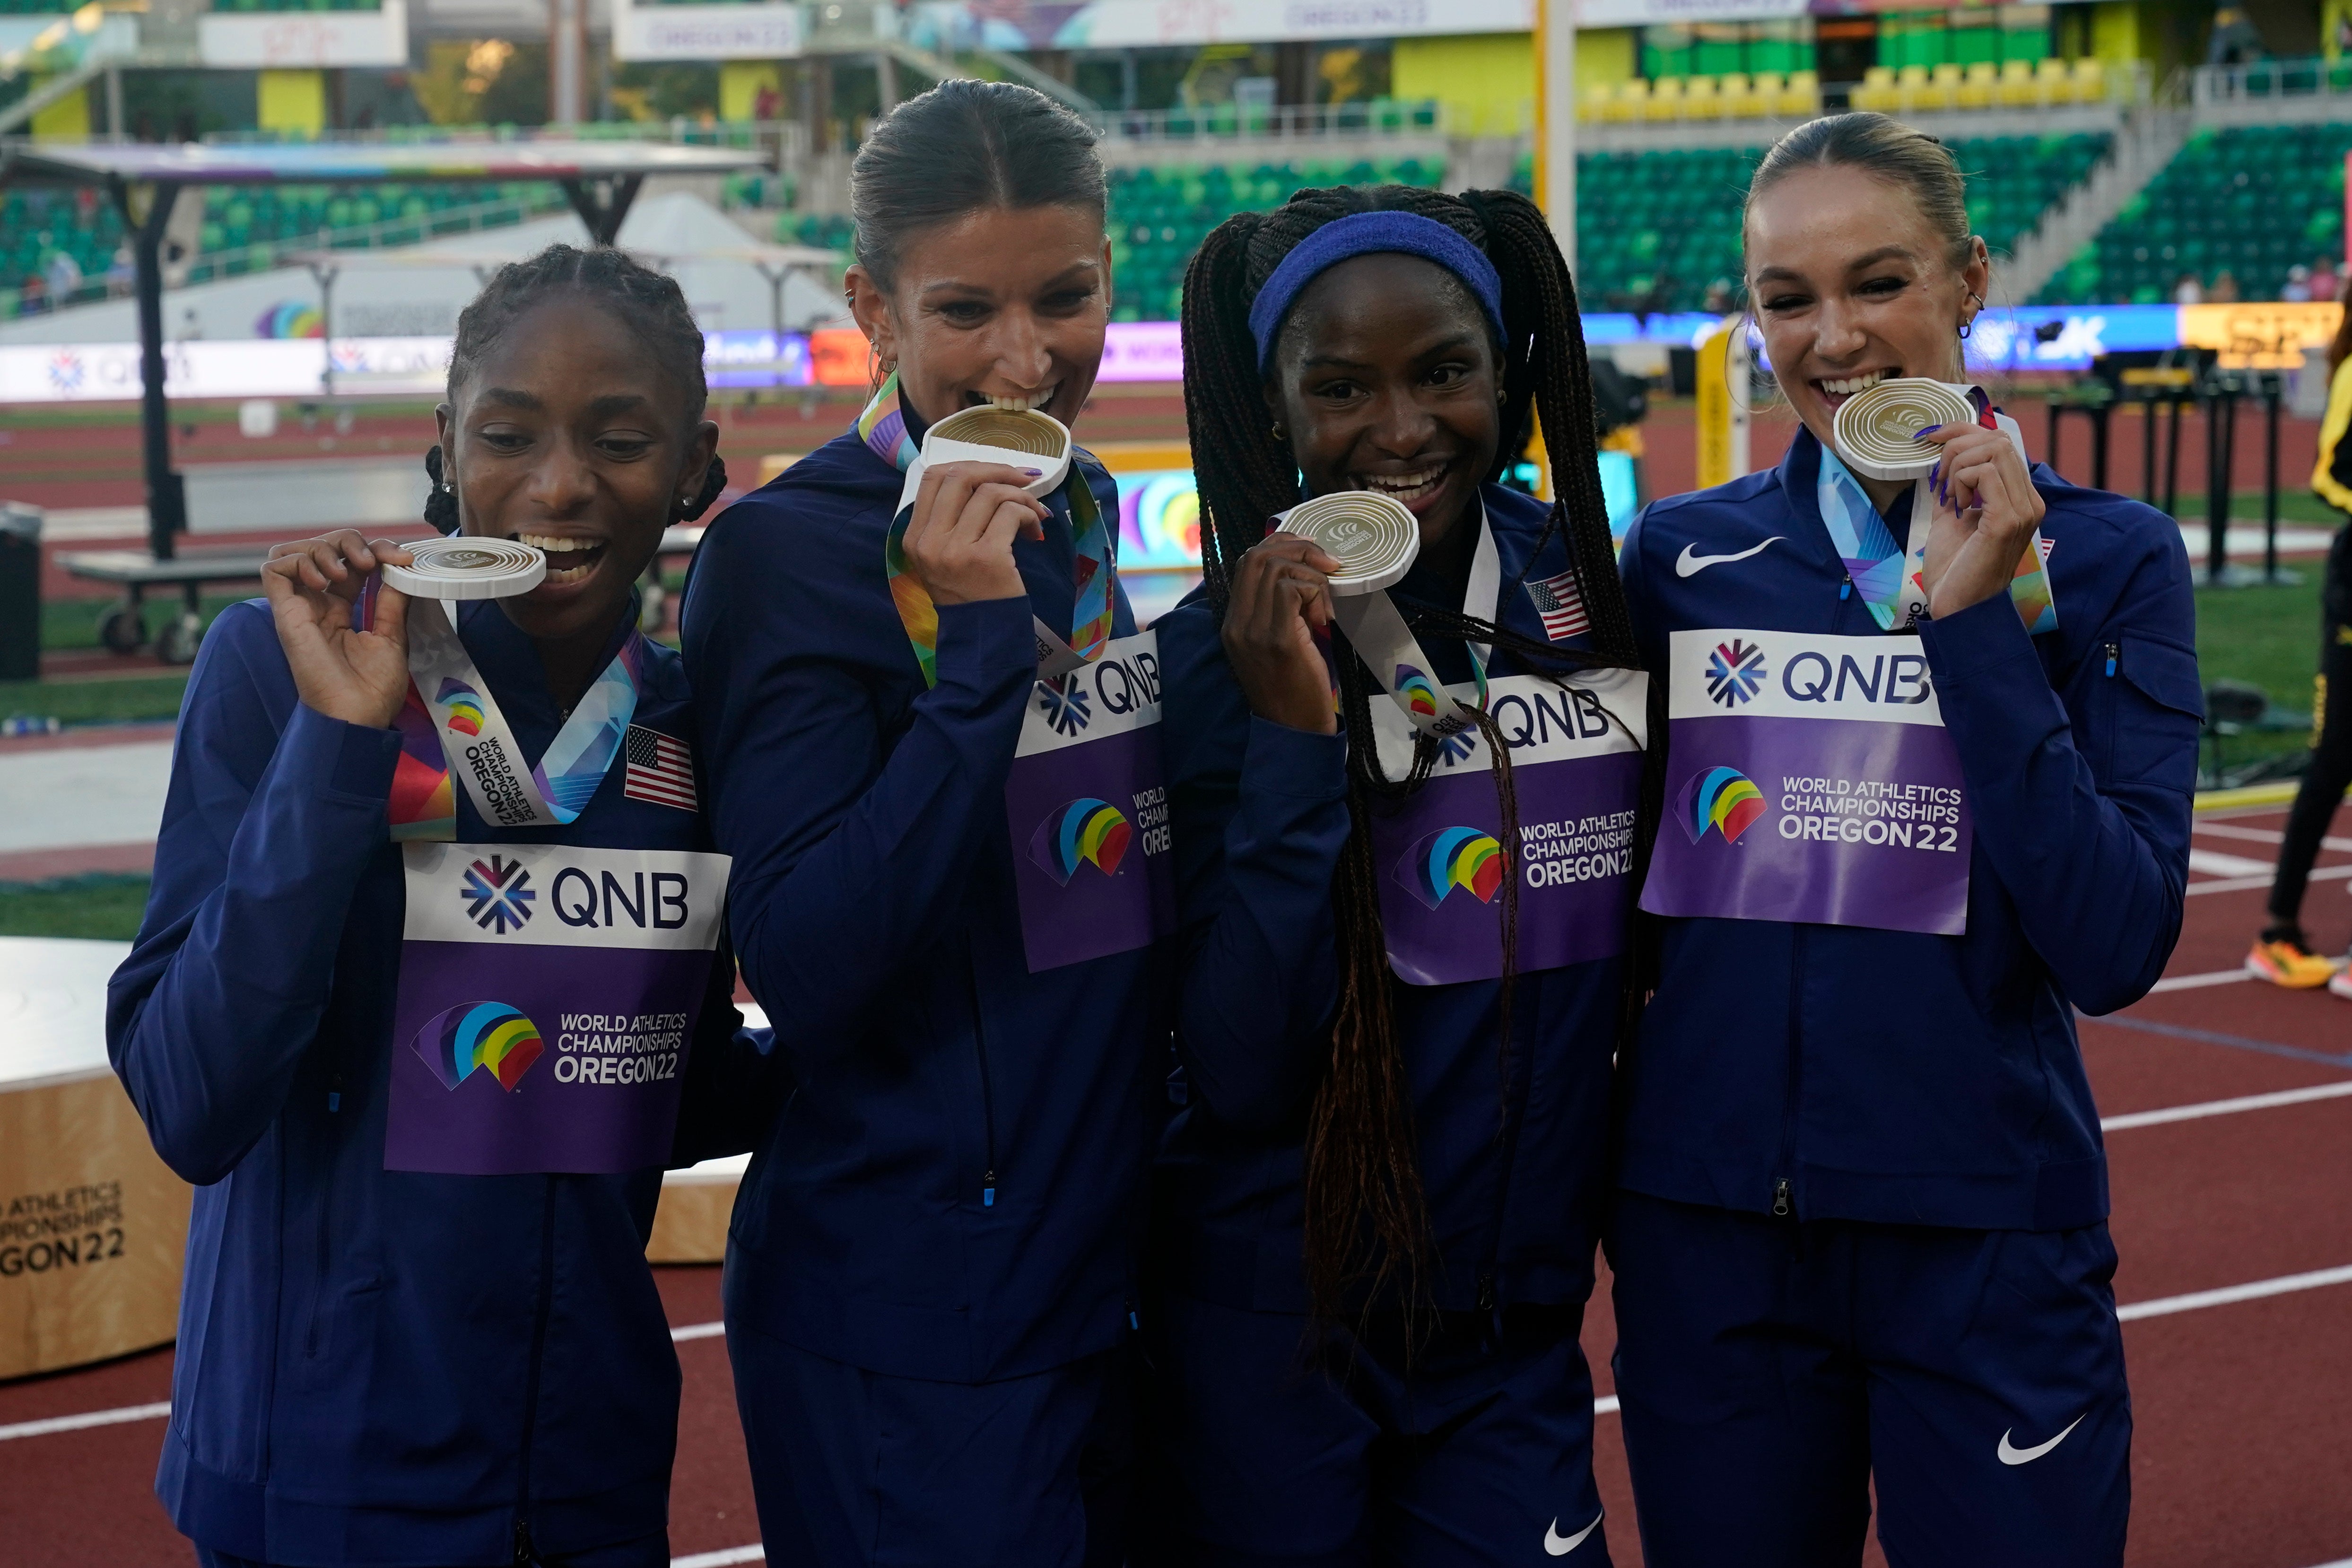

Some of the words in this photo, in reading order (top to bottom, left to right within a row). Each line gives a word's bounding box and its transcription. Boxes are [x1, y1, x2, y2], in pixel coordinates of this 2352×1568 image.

[1095, 652, 1161, 714] QNB
[1782, 652, 1930, 704] QNB
[1491, 688, 1609, 748] QNB
[479, 741, 528, 823] CHAMPIONSHIPS
[488, 736, 511, 773] WORLD
[505, 775, 537, 820] ATHLETICS
[1783, 776, 1850, 795] WORLD
[1854, 781, 1961, 805] ATHLETICS
[1132, 786, 1165, 810] WORLD
[1781, 794, 1959, 824] CHAMPIONSHIPS
[1142, 824, 1172, 857] ORE
[1519, 820, 1576, 842] WORLD
[1579, 810, 1635, 834] ATHLETICS
[1778, 814, 1958, 852] OREGON22
[1524, 828, 1633, 861] CHAMPIONSHIPS
[551, 867, 688, 929] QNB
[561, 1013, 627, 1032] WORLD
[630, 1013, 687, 1032] ATHLETICS
[558, 1031, 682, 1054] CHAMPIONSHIPS
[554, 1053, 677, 1084] OREGON22
